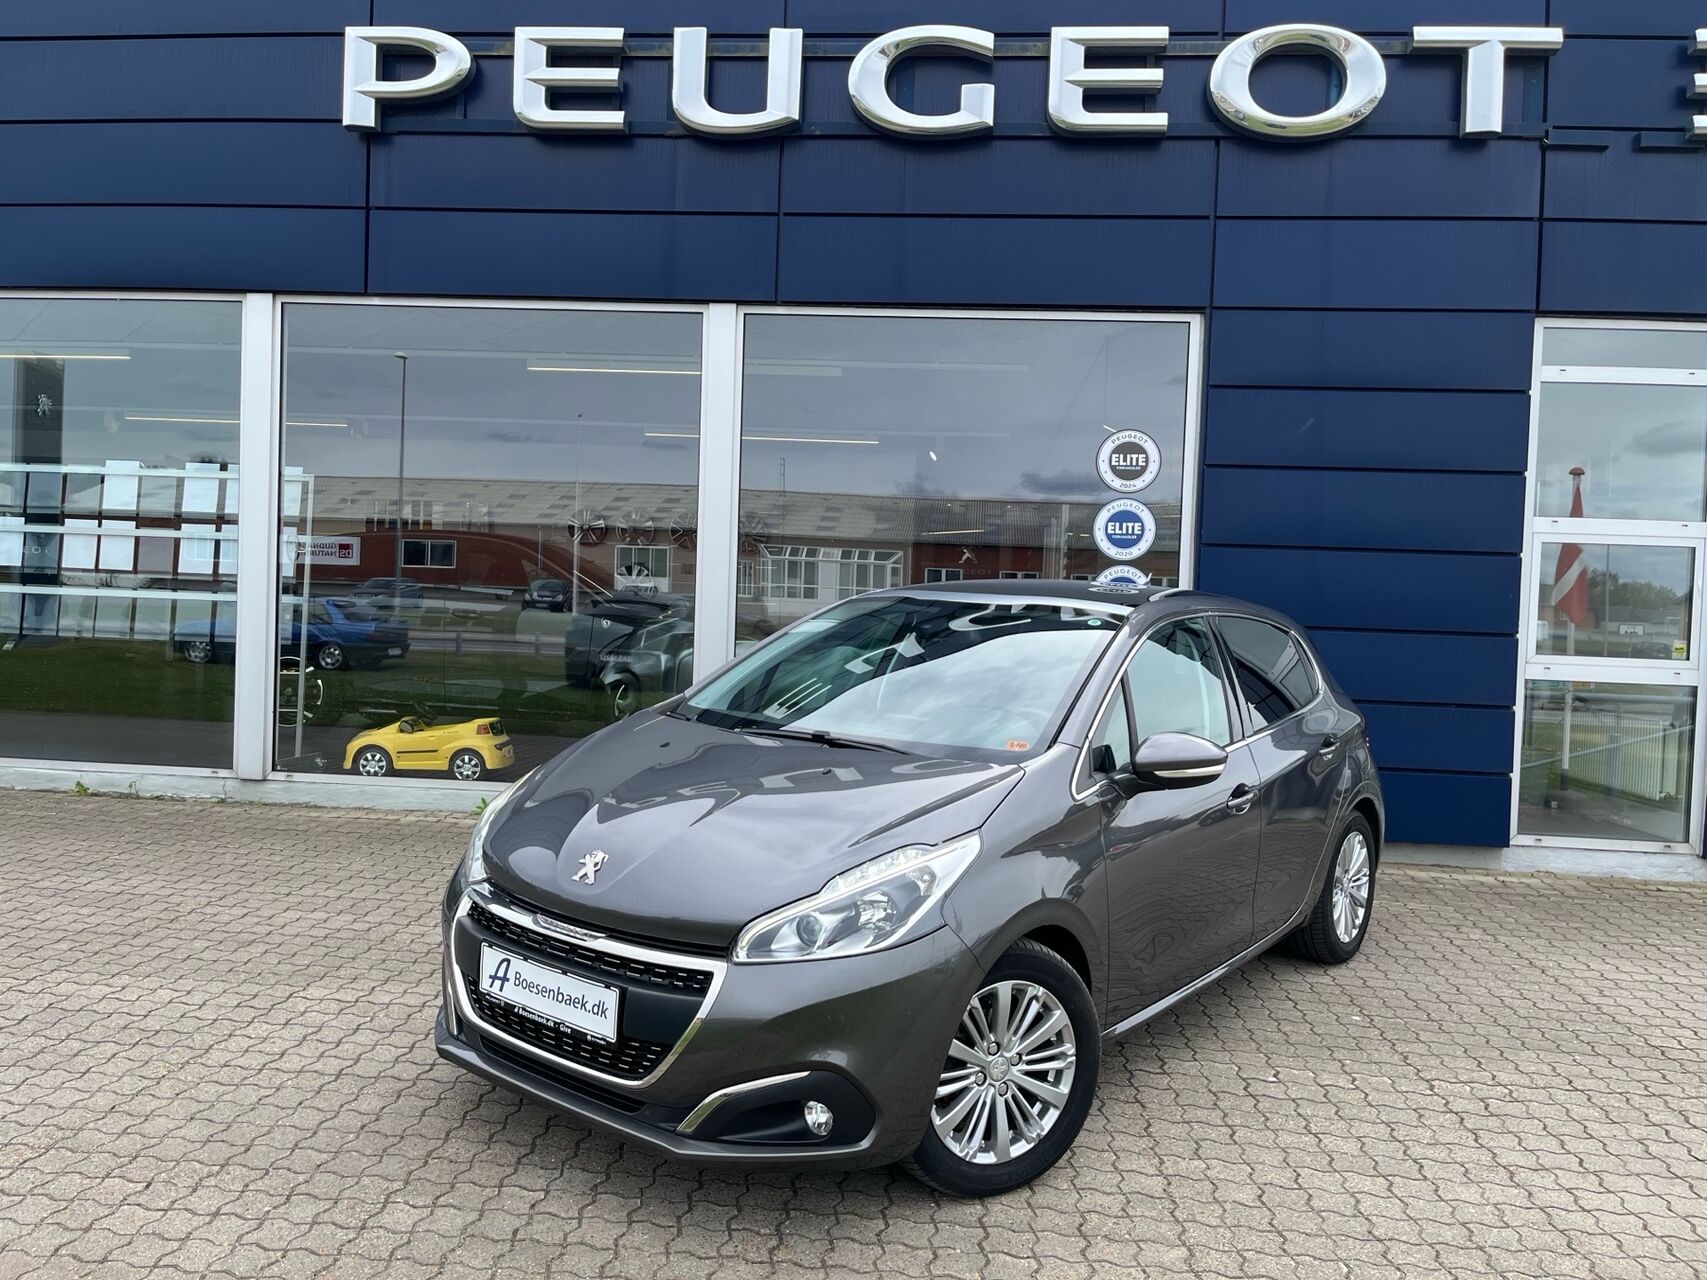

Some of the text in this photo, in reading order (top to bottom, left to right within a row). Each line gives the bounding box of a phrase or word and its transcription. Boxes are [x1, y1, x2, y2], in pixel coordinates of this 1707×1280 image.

[343, 23, 1564, 140] PEUGEOT
[1111, 433, 1148, 444] PEUGEOT
[1111, 453, 1146, 466] ELITE
[1106, 501, 1145, 513] PEUGEOT
[1107, 522, 1142, 534] ELITE
[1103, 568, 1142, 580] PEUGEOT
[513, 971, 609, 1019] Boesenbaek.dk
[559, 1023, 572, 1034] Give
